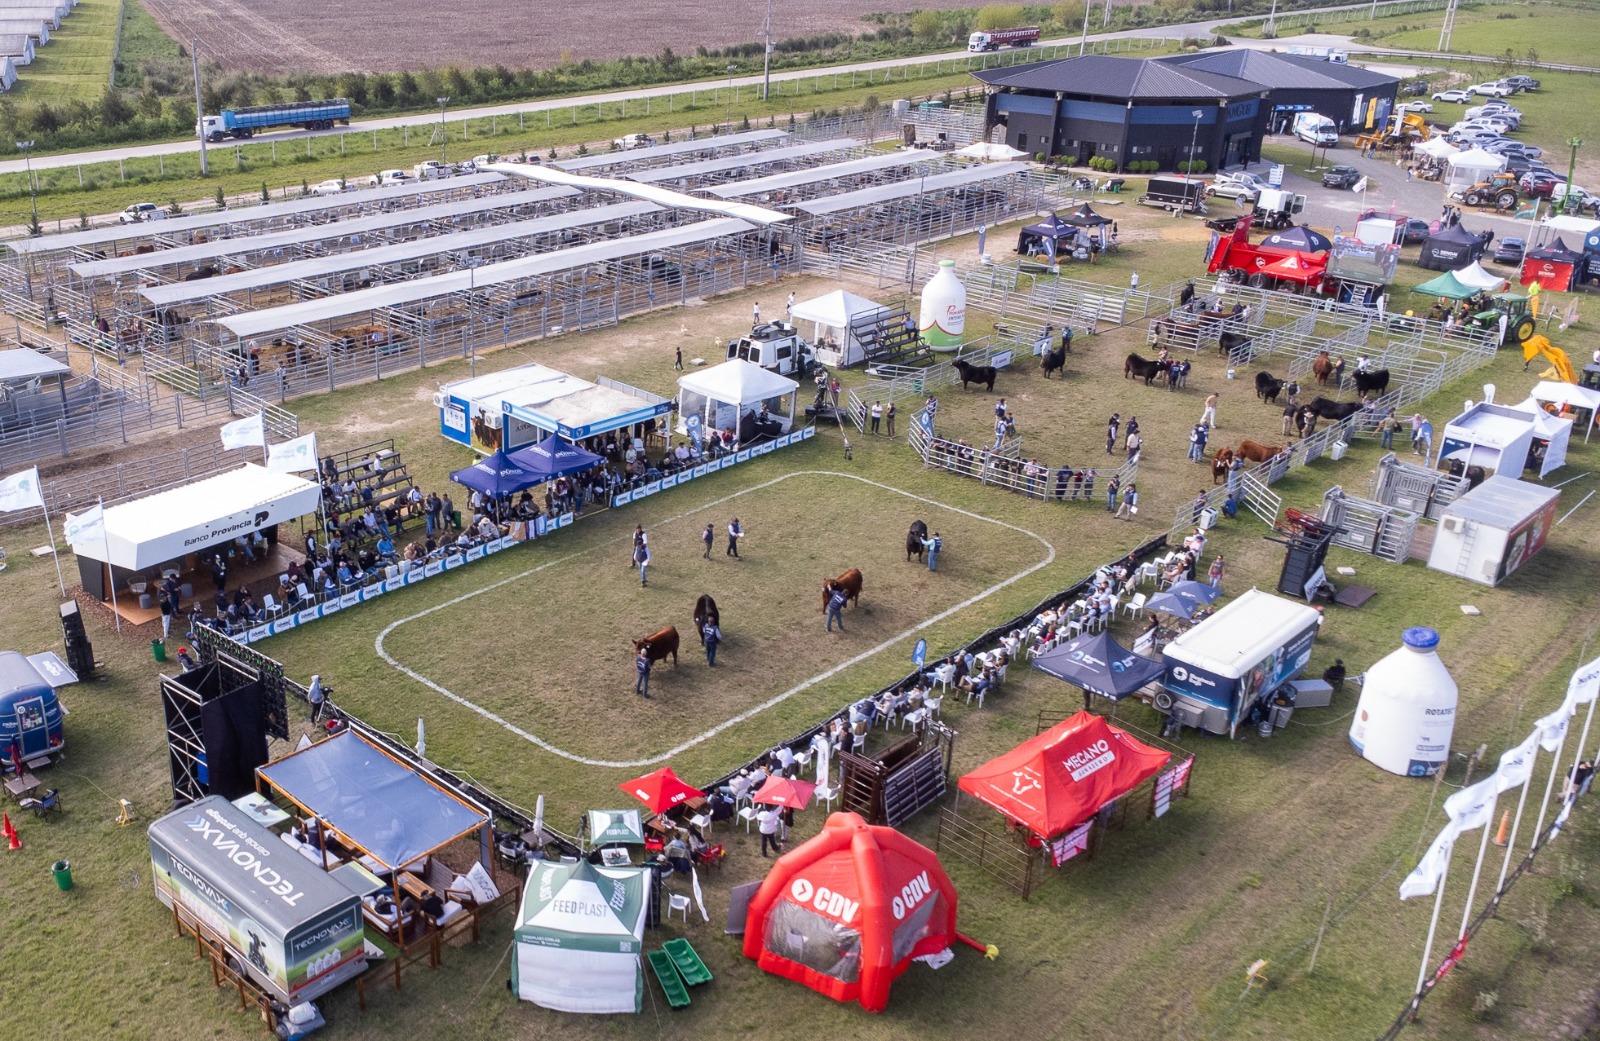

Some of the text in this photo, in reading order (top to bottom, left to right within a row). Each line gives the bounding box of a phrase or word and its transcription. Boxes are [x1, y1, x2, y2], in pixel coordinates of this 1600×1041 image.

[184, 533, 209, 547] Banco
[211, 519, 252, 538] Provincia
[1062, 739, 1109, 772] MECANO
[191, 821, 304, 907] TECNOVAX
[170, 856, 228, 910] TECNOVAX
[902, 870, 931, 909] CDV
[813, 887, 860, 923] CDV
